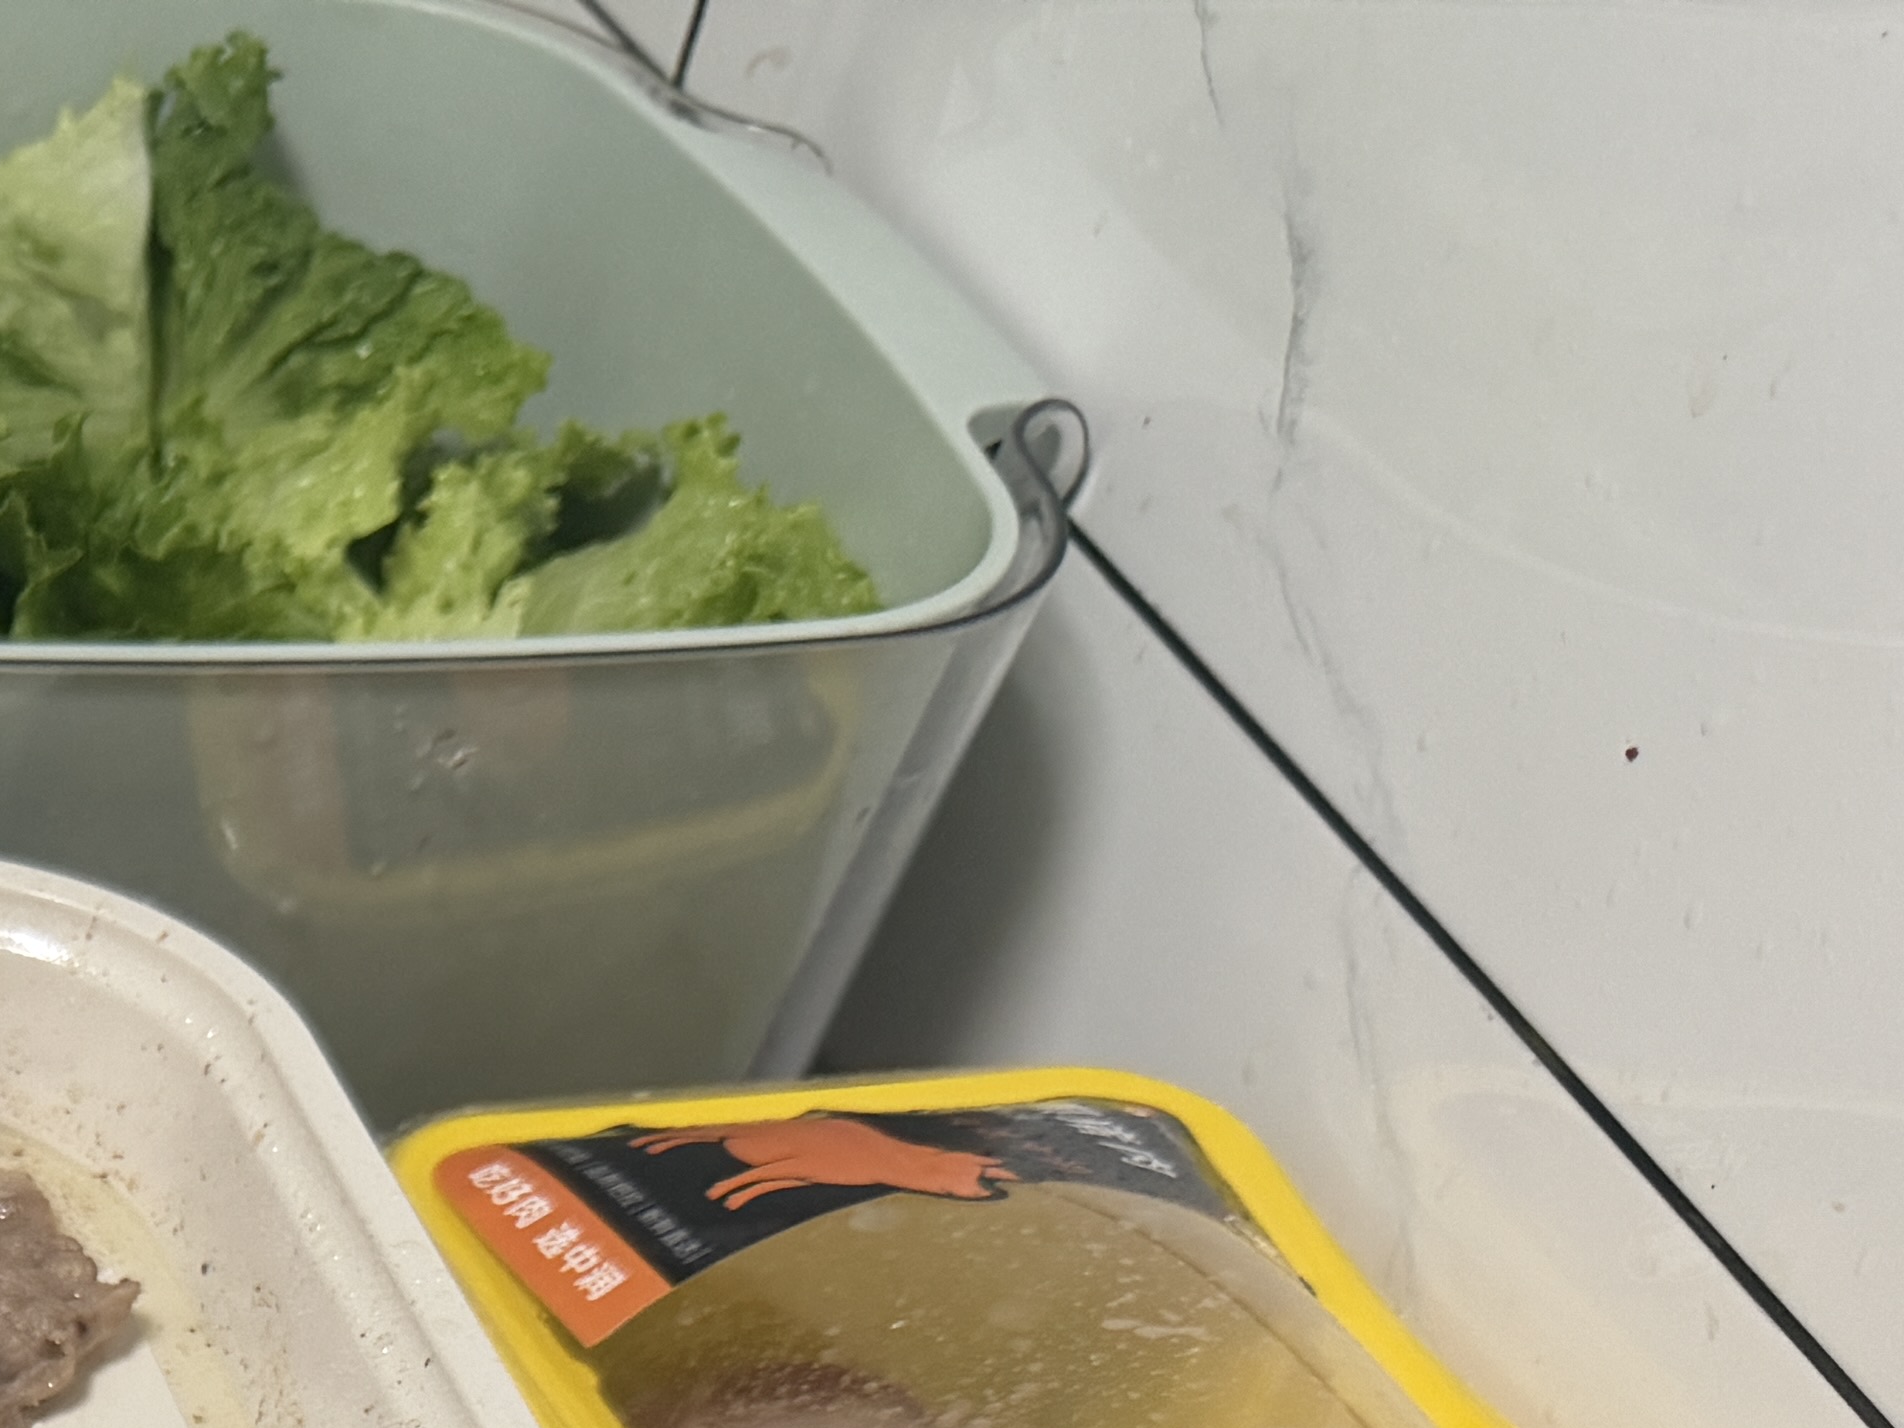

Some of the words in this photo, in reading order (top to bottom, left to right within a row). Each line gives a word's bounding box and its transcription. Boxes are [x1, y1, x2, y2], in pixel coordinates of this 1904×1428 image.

[466, 1160, 554, 1230] 吃好肉
[532, 1223, 626, 1304] 选中润
